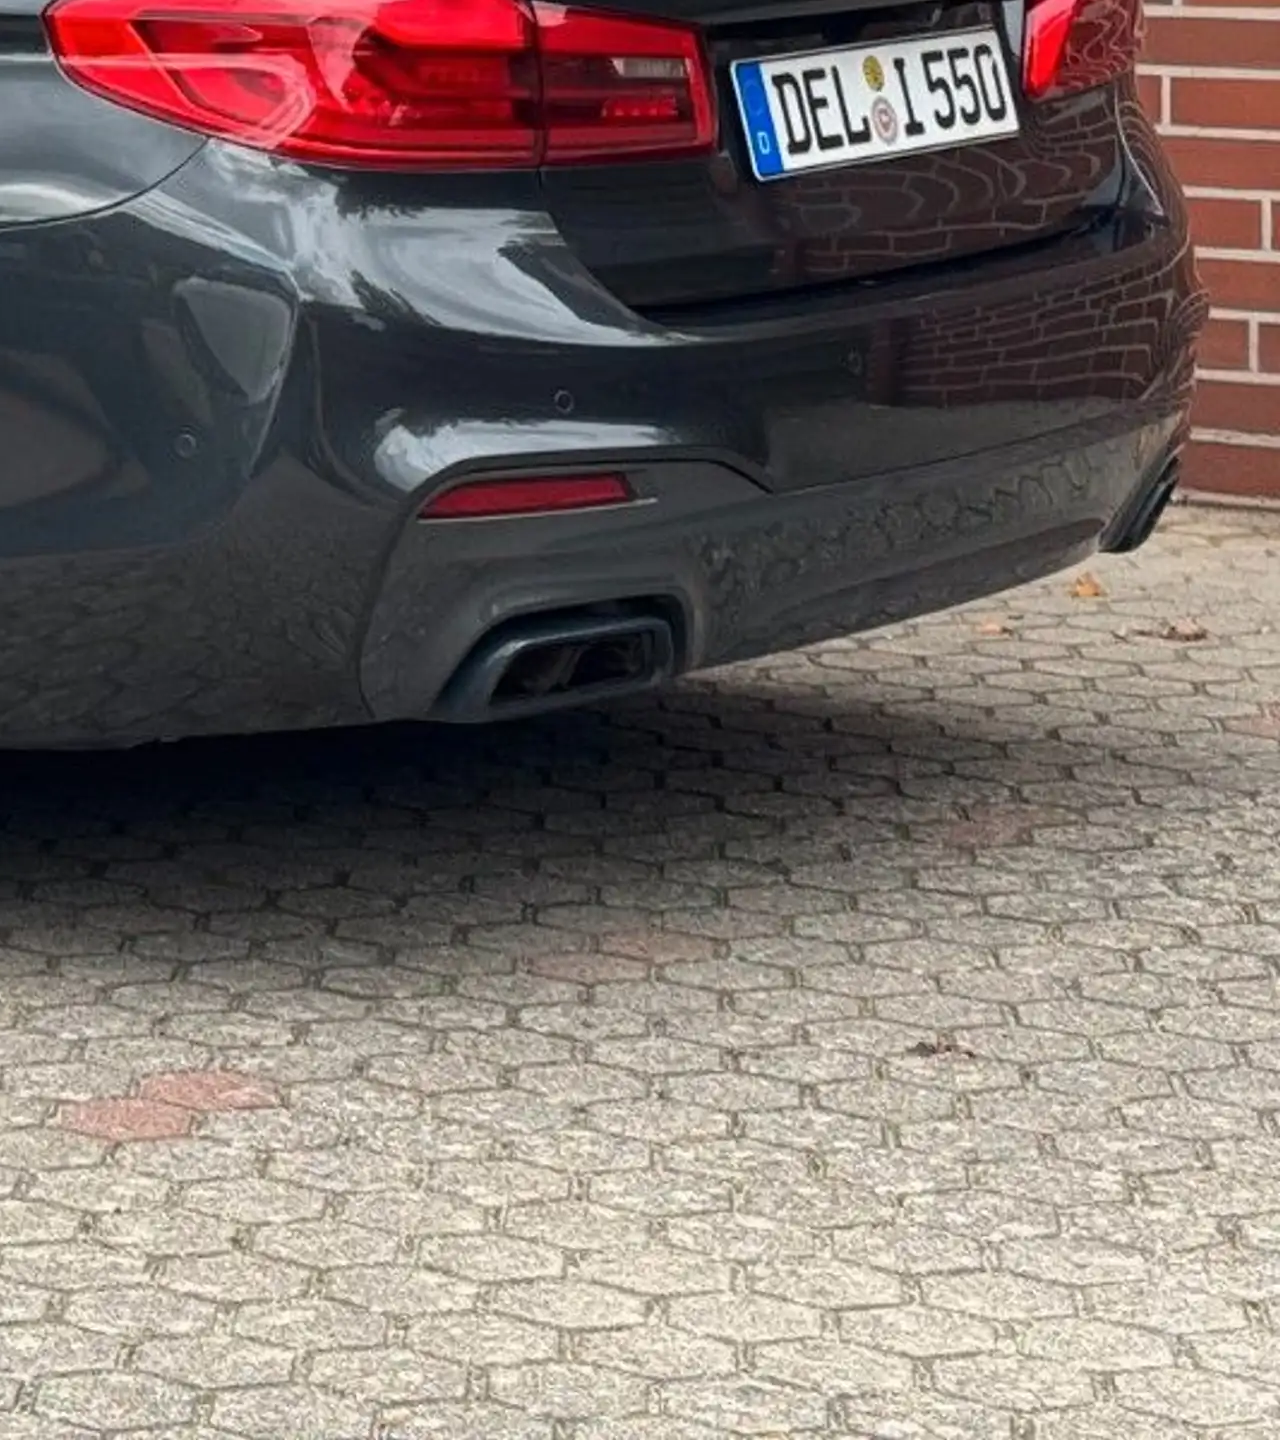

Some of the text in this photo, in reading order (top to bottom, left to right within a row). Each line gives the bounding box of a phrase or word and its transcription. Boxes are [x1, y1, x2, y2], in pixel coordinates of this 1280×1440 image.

[771, 65, 872, 156] DEL
[893, 57, 925, 137] I
[920, 44, 1006, 130] 550
